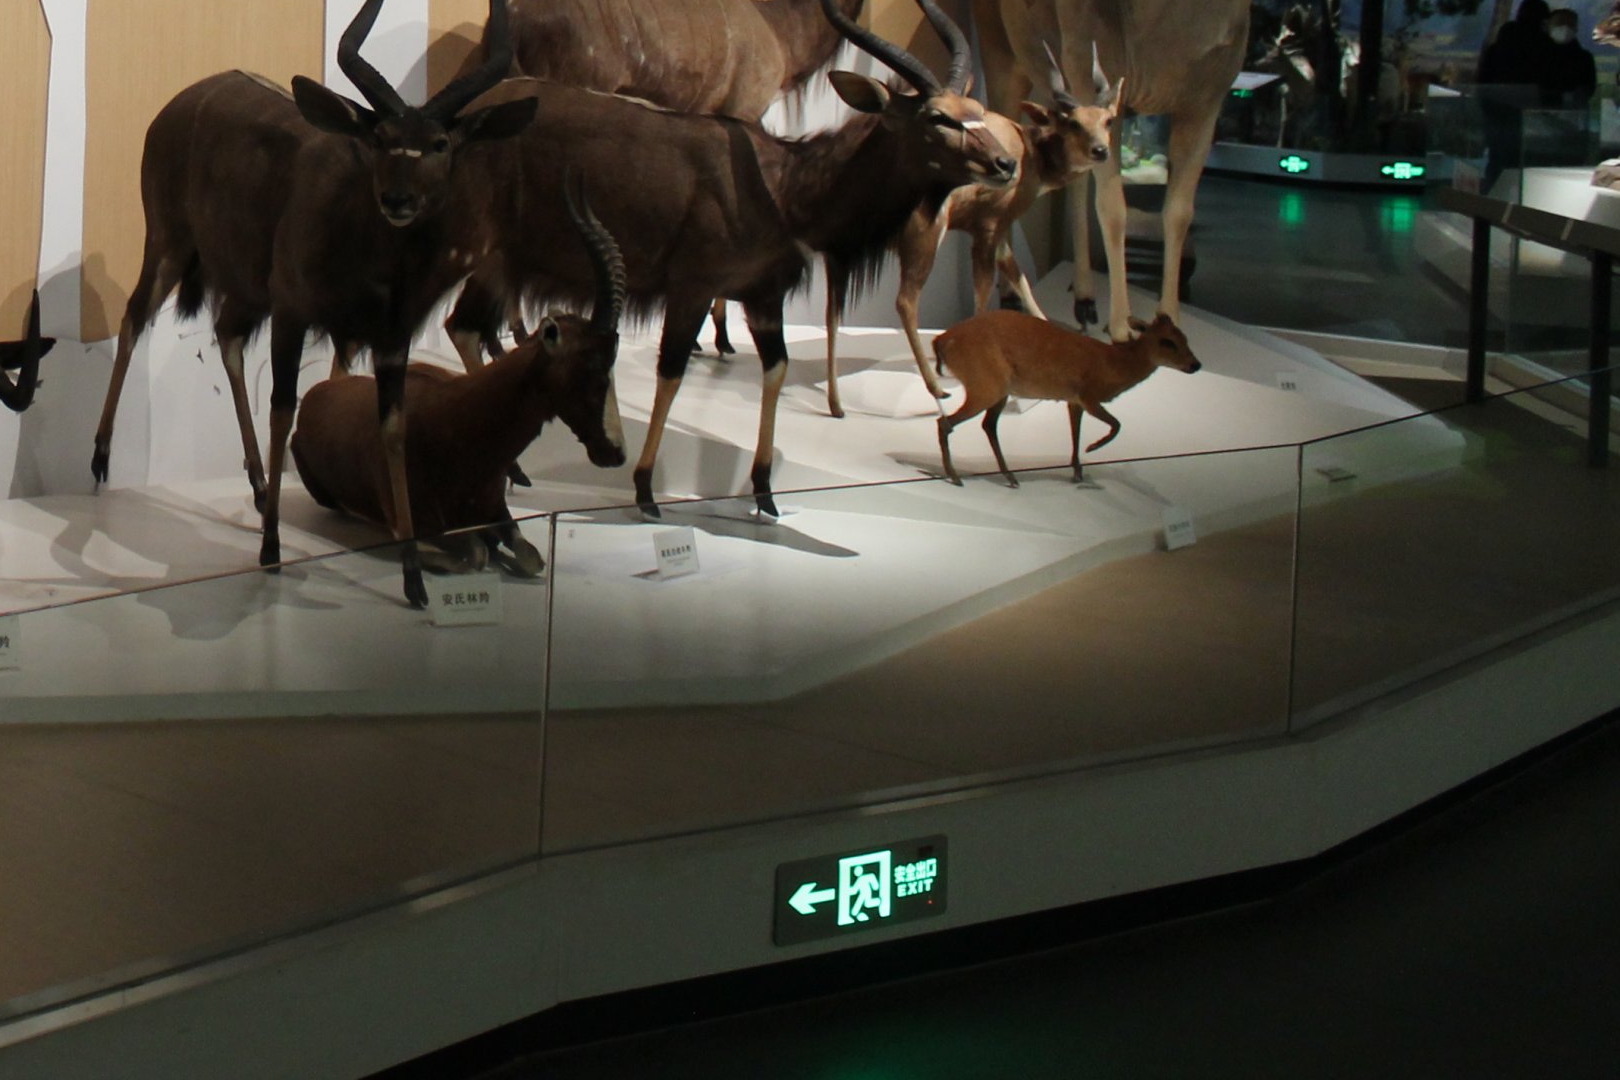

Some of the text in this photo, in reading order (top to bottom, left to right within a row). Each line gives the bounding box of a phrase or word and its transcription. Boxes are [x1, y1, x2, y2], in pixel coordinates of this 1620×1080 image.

[894, 858, 937, 884] 安全出口
[897, 878, 933, 897] EXIT
